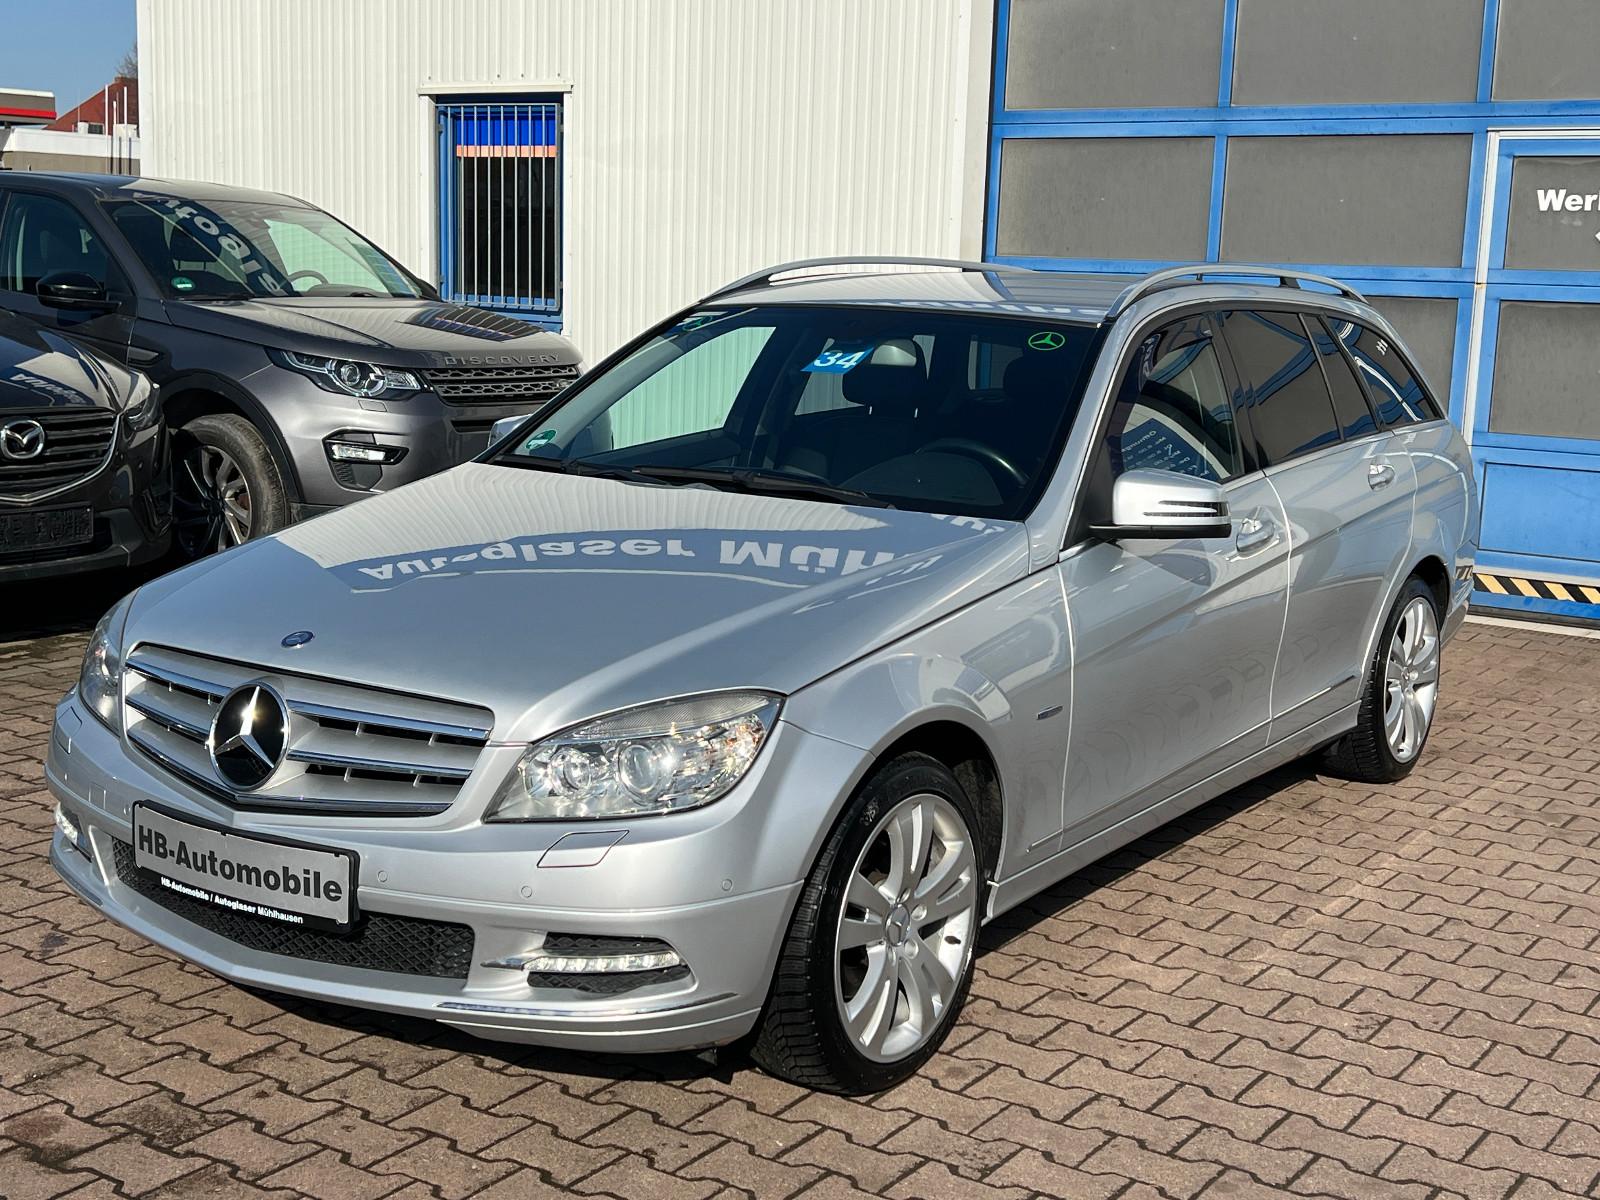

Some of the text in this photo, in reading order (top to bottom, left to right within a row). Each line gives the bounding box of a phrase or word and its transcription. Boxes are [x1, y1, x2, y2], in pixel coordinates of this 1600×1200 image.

[1536, 189, 1600, 212] Wer
[444, 354, 559, 366] DISCOVERY
[813, 351, 865, 369] 34
[138, 825, 342, 902] HB-Automobile
[161, 877, 209, 900] HB-Automobile
[215, 895, 256, 913] Autoglaser
[257, 906, 303, 923] Mühlhausen
